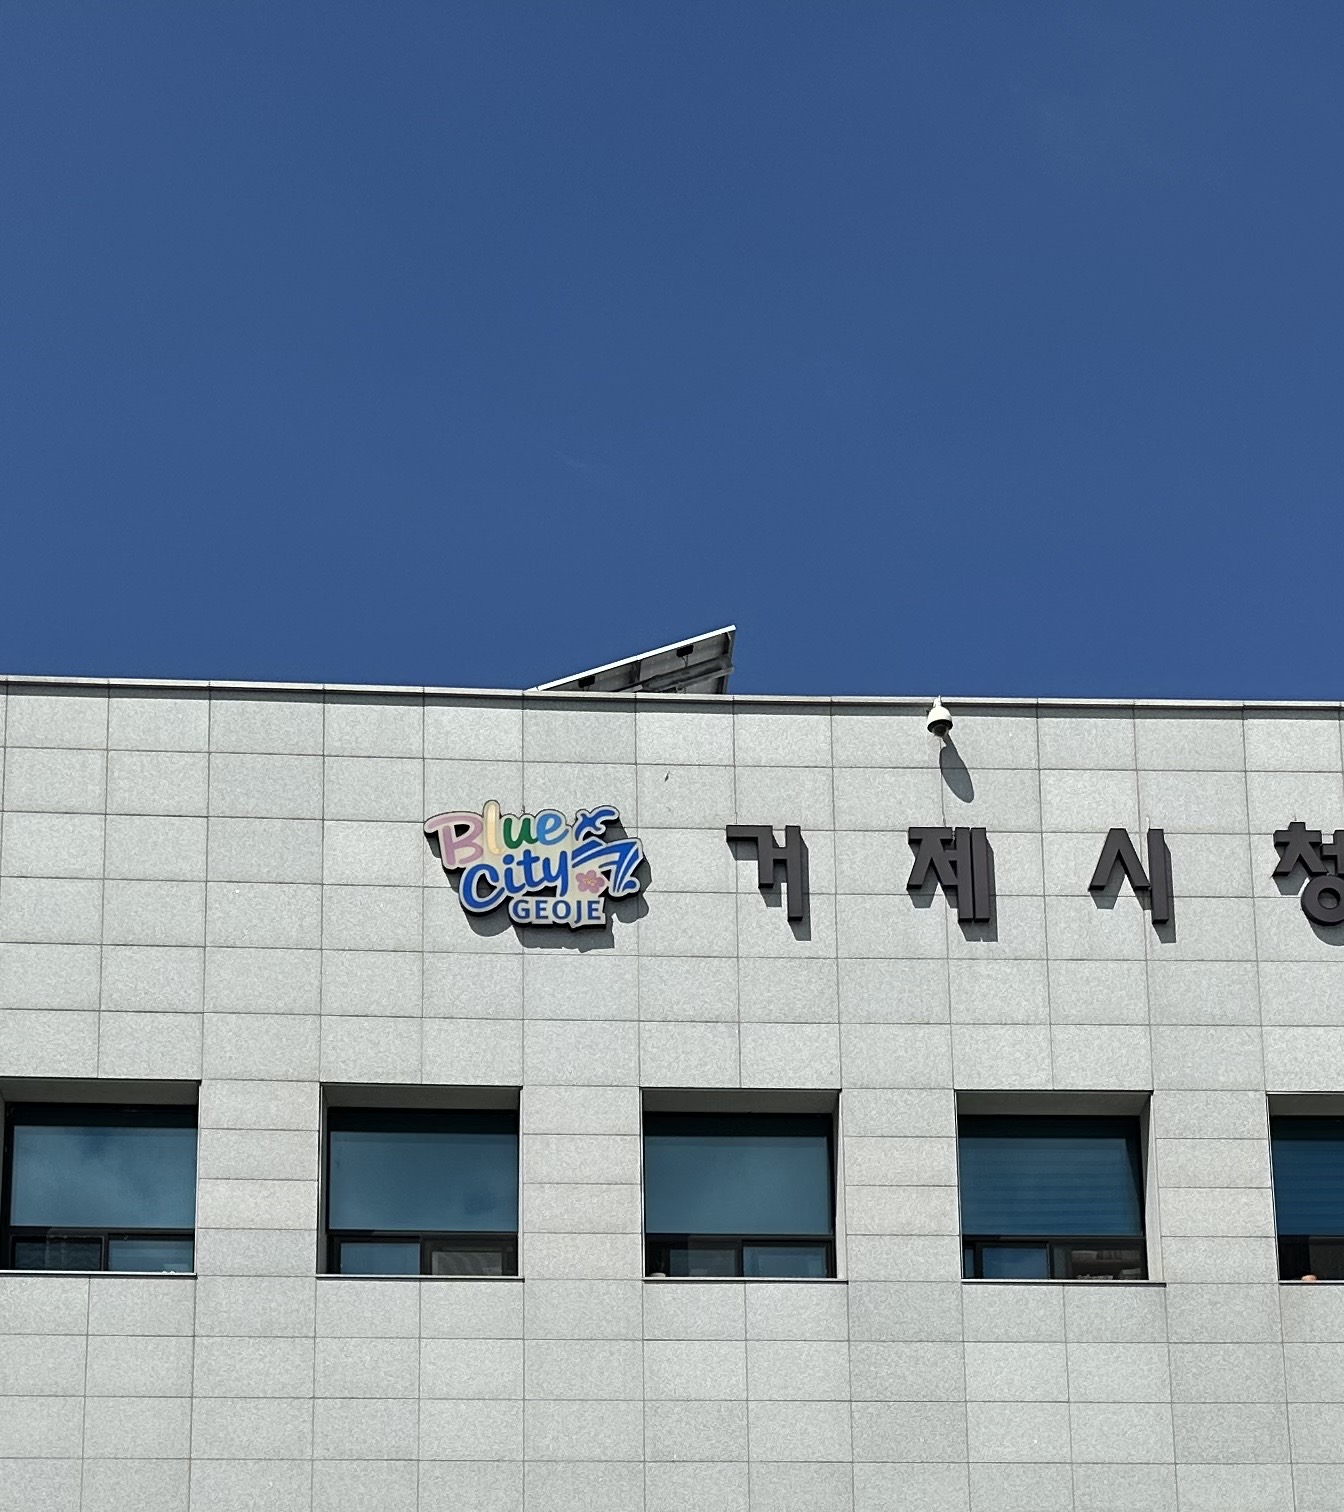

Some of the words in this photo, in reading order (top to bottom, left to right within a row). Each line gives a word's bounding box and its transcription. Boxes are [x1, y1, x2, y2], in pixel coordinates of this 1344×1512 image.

[425, 801, 569, 865] Blue
[461, 849, 570, 909] City
[512, 899, 602, 924] GEOJE
